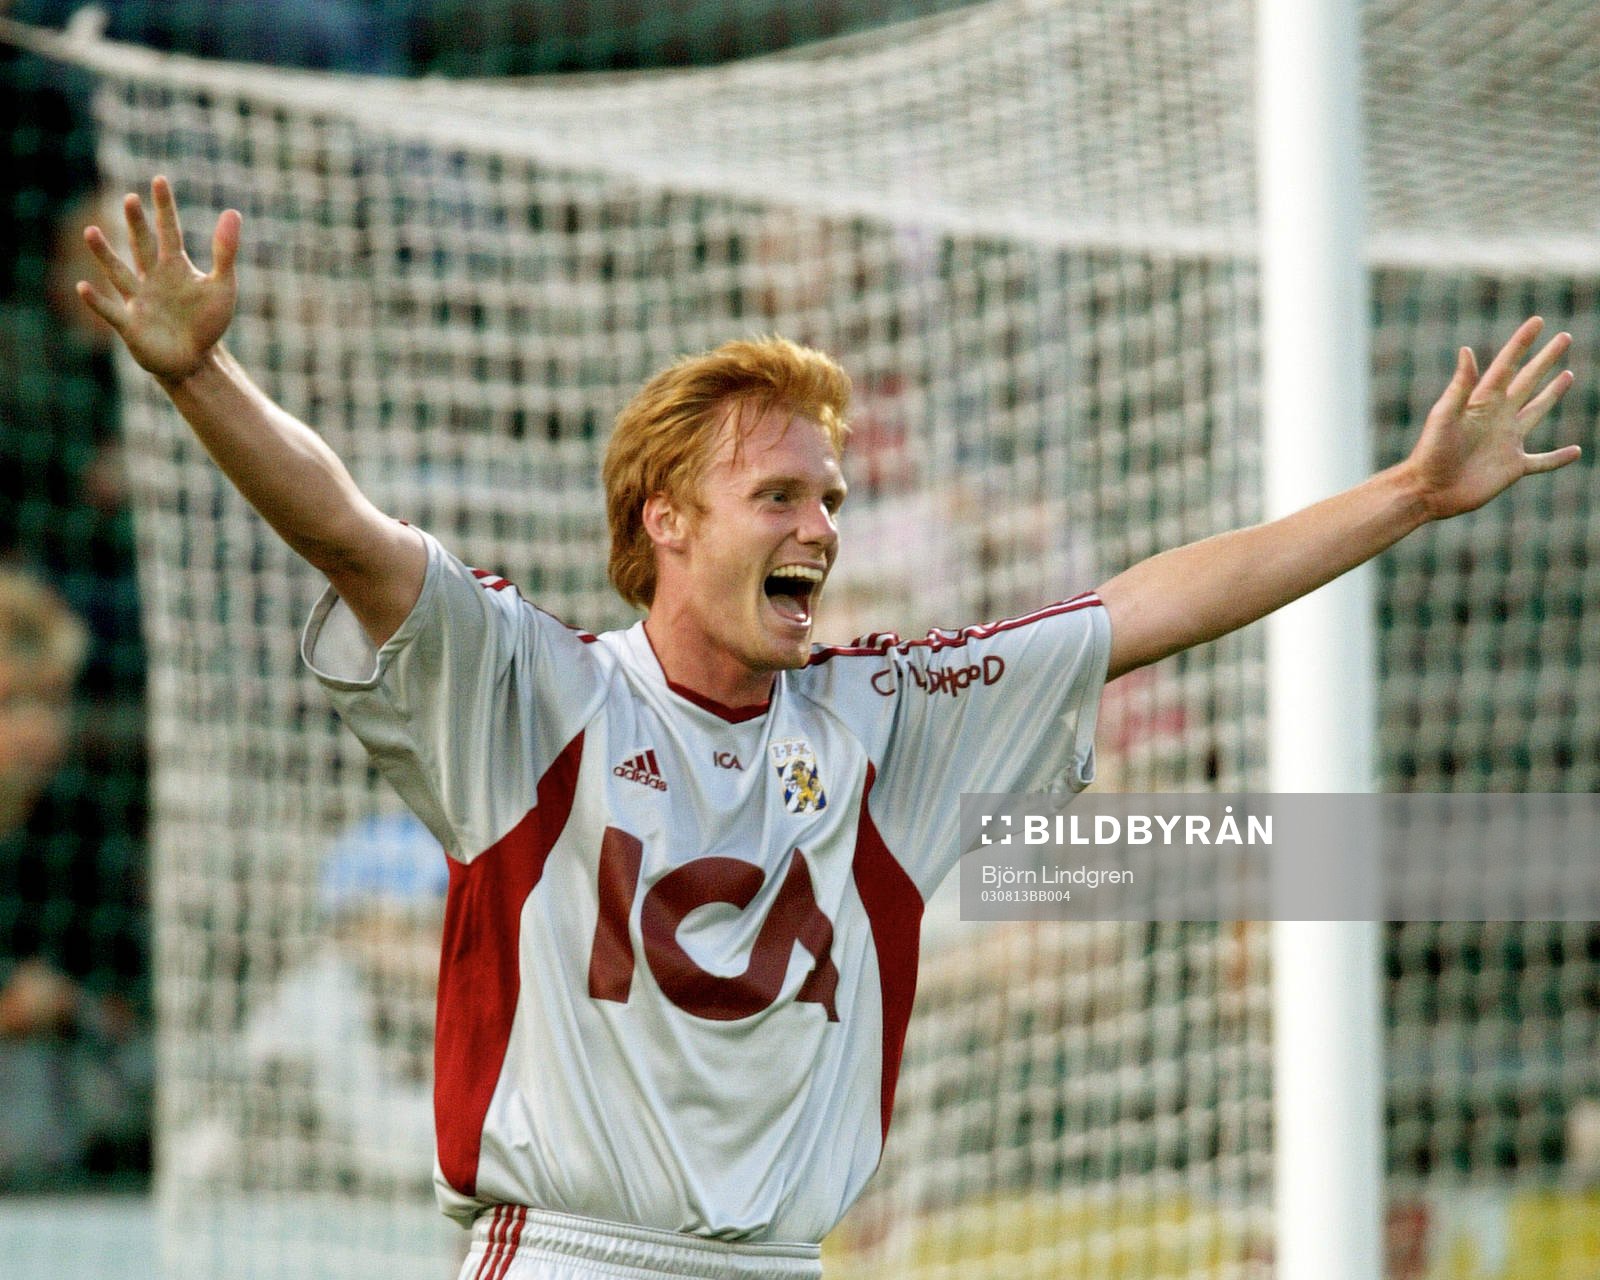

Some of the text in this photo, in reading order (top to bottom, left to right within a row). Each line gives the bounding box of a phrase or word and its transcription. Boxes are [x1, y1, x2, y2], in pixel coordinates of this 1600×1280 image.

[713, 751, 744, 771] ICA
[613, 765, 668, 792] adidas
[588, 826, 840, 1022] ICA
